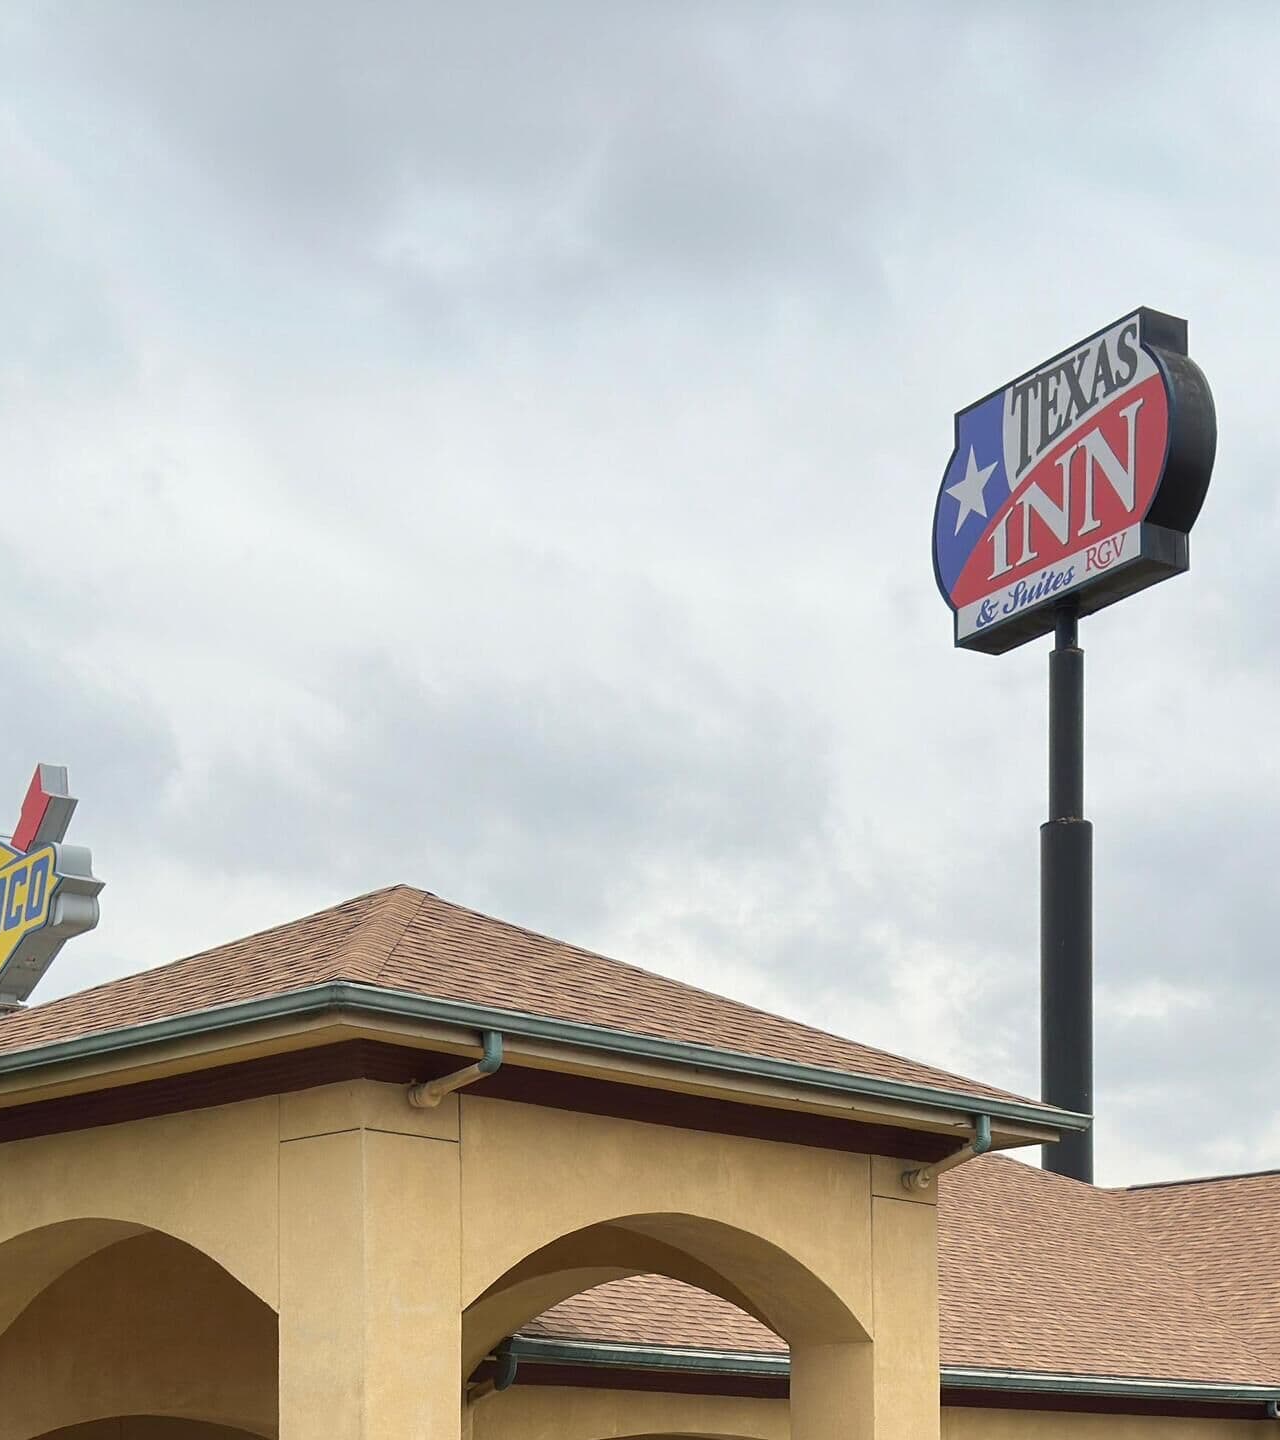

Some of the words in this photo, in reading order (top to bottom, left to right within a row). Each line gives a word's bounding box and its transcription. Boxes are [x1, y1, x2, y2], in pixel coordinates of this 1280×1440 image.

[1009, 322, 1139, 479] TEXAS
[987, 397, 1145, 582] INN
[975, 597, 998, 629] &
[1002, 565, 1076, 615] Suites
[1085, 533, 1129, 572] RGV
